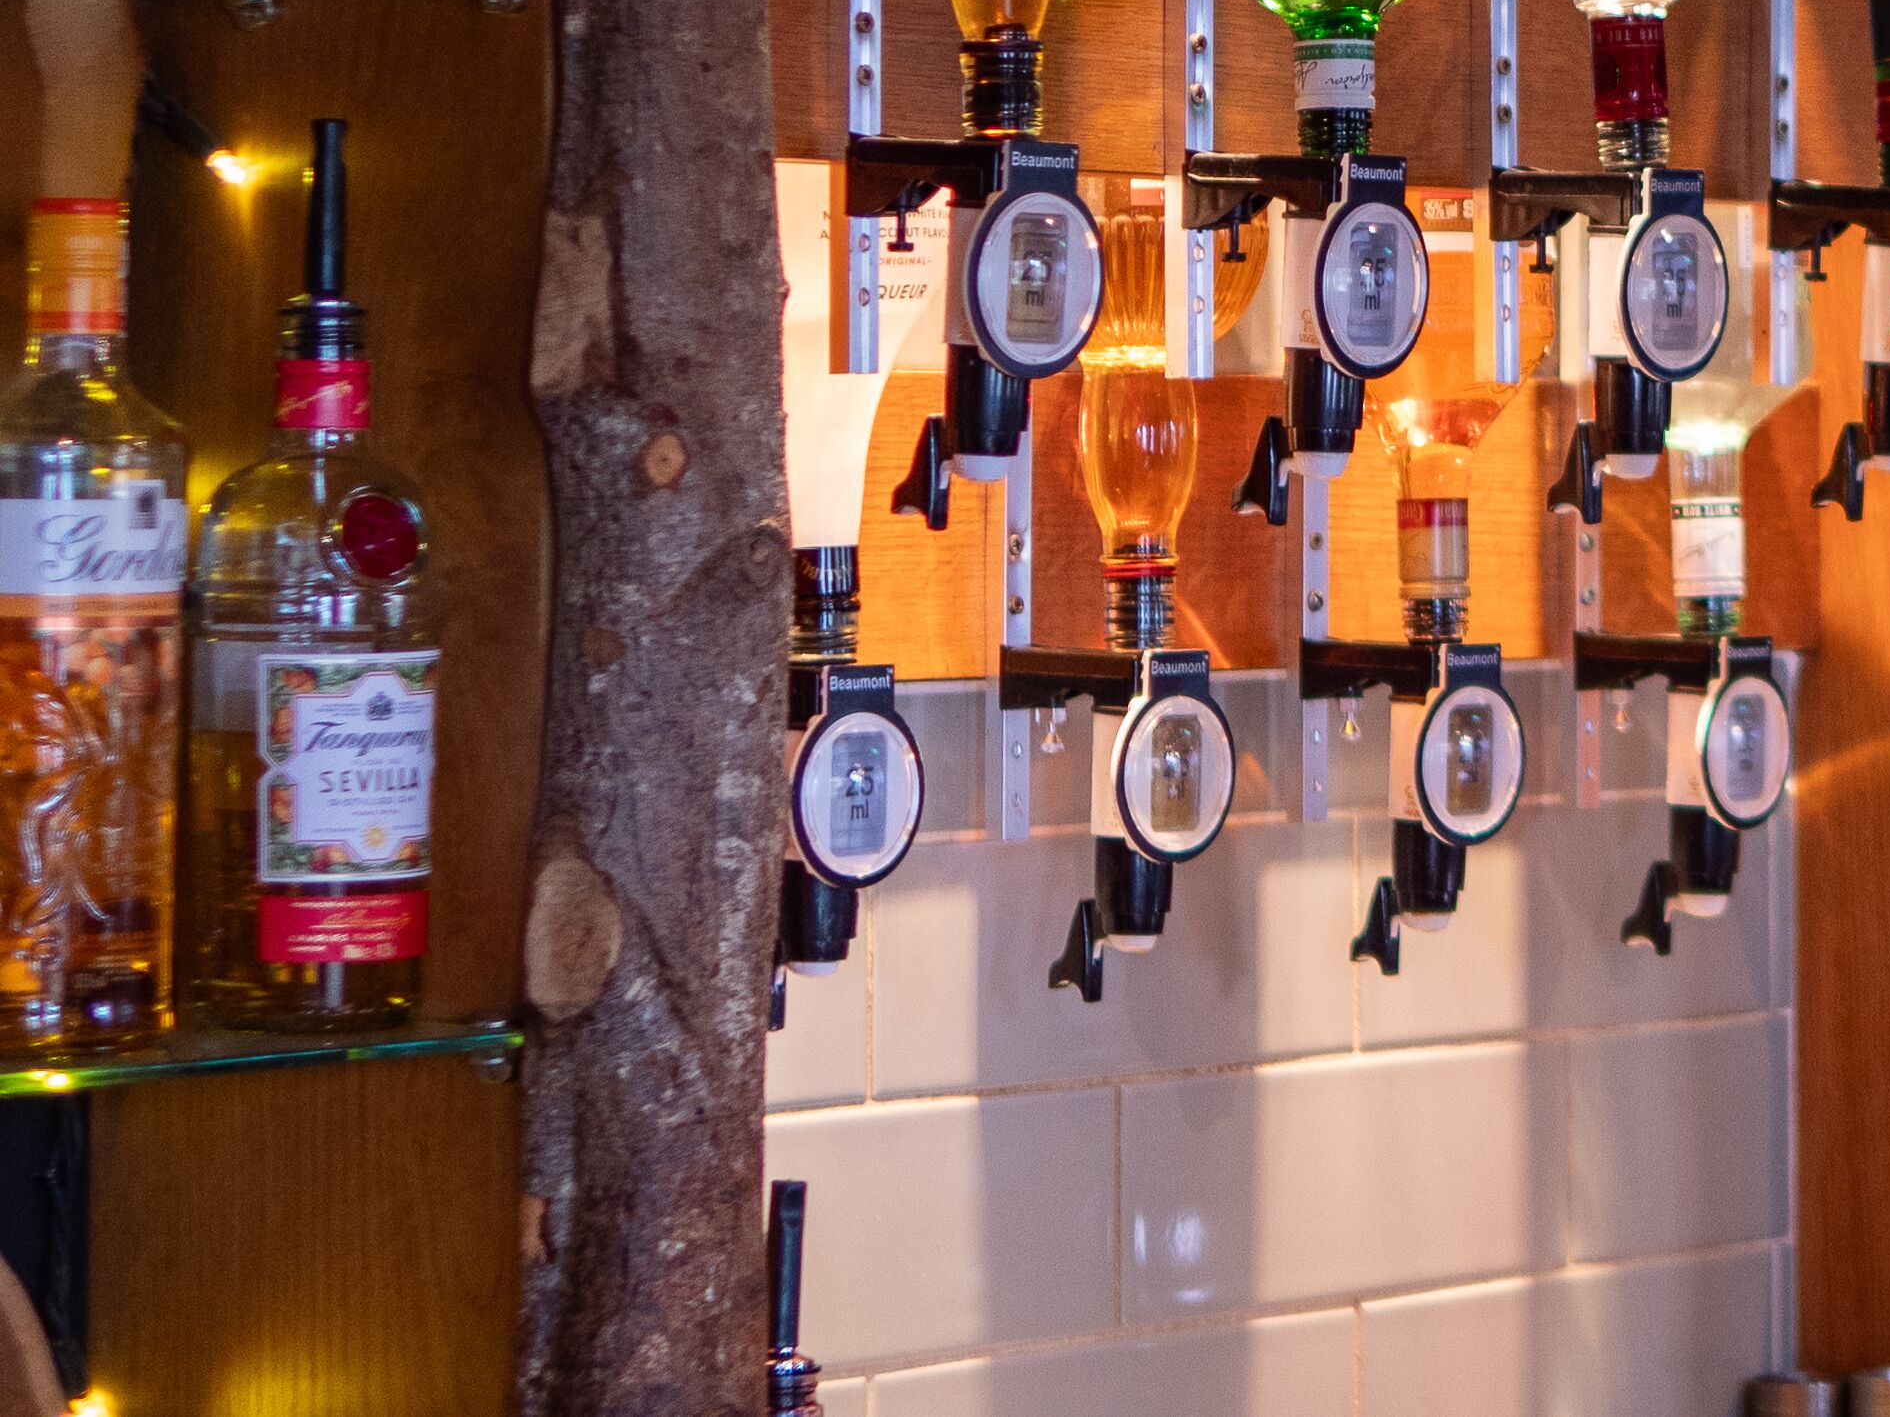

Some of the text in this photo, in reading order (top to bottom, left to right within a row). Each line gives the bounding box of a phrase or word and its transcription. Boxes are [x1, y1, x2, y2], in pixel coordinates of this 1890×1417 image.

[1011, 150, 1075, 169] Beaumont
[1350, 163, 1404, 182] Beaumont
[1651, 177, 1701, 193] Beaumont
[877, 284, 928, 300] QUEUR
[1364, 291, 1381, 311] ml
[1667, 302, 1683, 318] ml
[1151, 660, 1206, 675] Beaumont
[1447, 651, 1498, 667] Beaumont
[829, 674, 891, 692] Beaumont
[319, 767, 419, 794] SEVILLA
[850, 800, 869, 821] ml
